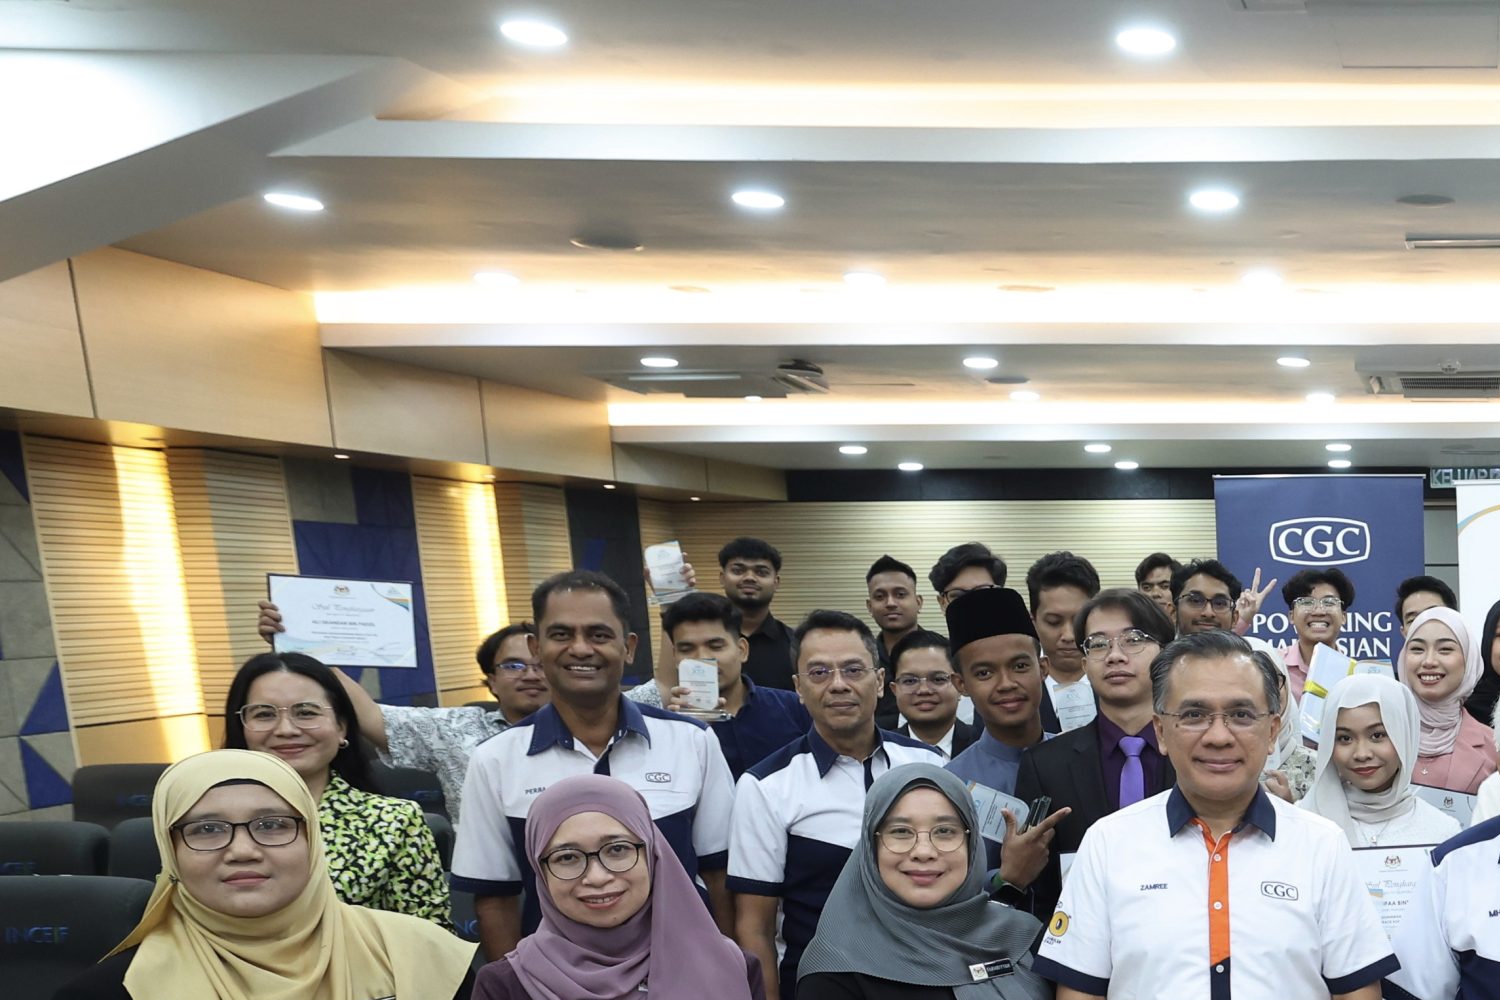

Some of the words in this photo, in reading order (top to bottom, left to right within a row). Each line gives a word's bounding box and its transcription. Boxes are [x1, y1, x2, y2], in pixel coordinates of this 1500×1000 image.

[1278, 525, 1360, 558] CGC
[1252, 611, 1392, 634] POING
[647, 774, 669, 782] CGC
[1140, 883, 1168, 891] ZAMREE
[1263, 883, 1295, 899] CGC
